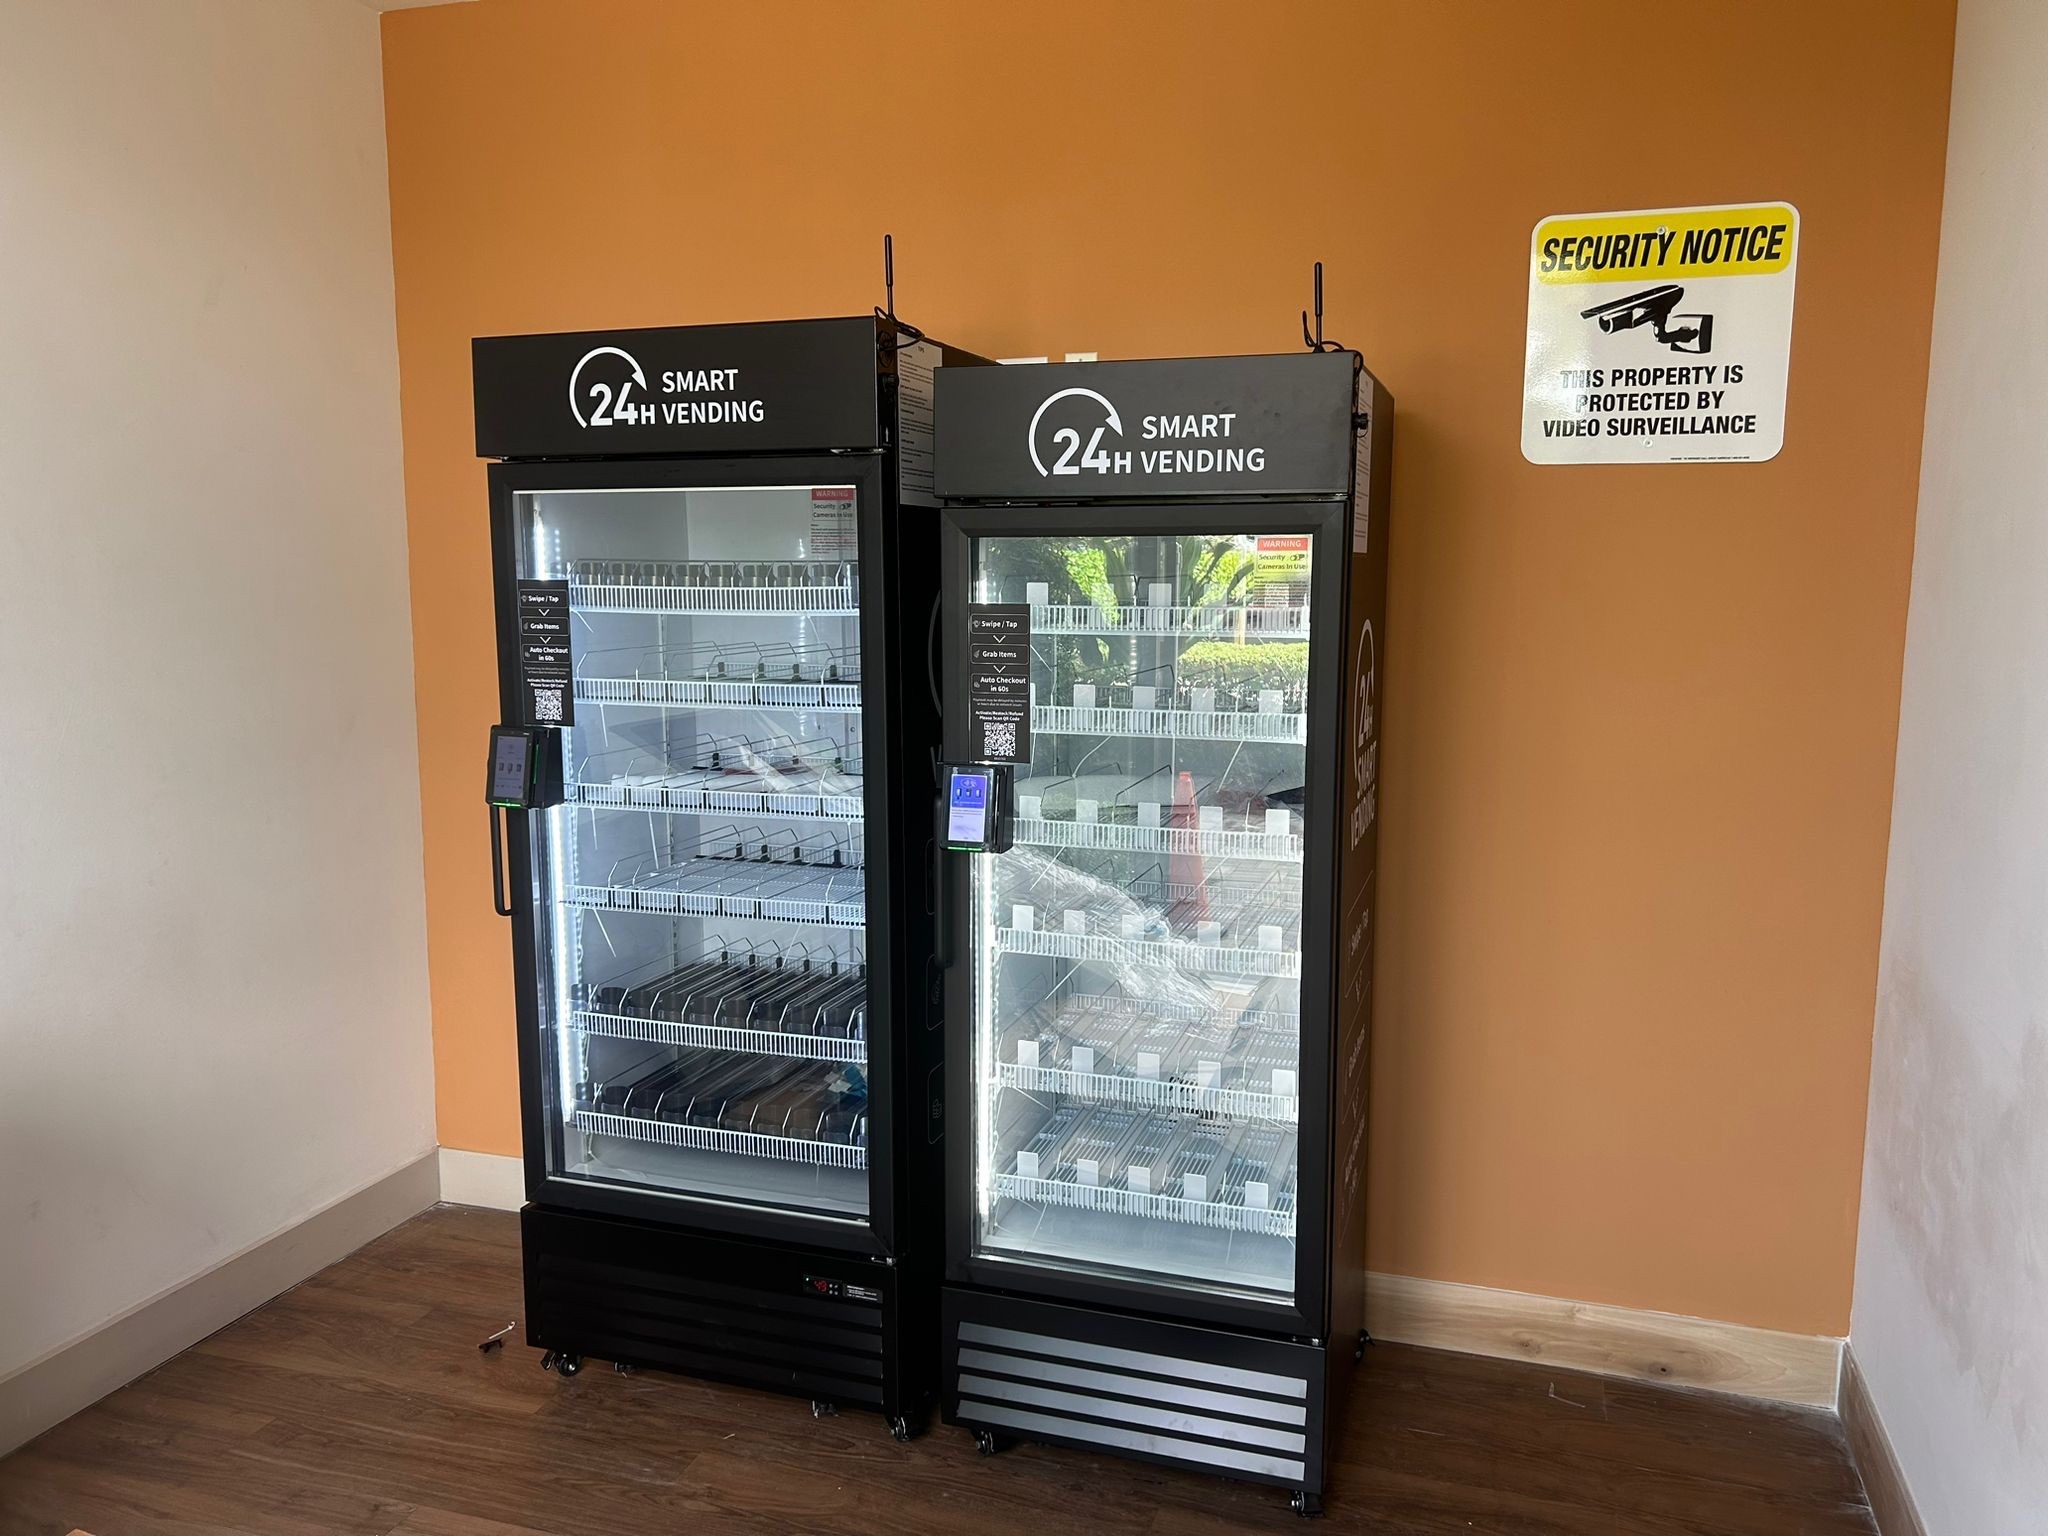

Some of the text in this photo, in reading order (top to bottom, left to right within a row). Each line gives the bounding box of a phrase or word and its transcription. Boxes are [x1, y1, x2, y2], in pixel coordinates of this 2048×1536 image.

[1540, 224, 1787, 273] SECURITY NOTICE
[661, 368, 739, 393] SMART
[1560, 364, 1744, 389] THIS PROPERTY IS
[661, 400, 765, 425] VENDING
[1575, 390, 1725, 413] PROTECTED BY
[1141, 413, 1236, 440] SMART
[1543, 415, 1757, 438] VIDEO SURVEILLANCE
[1140, 447, 1265, 474] VENDING
